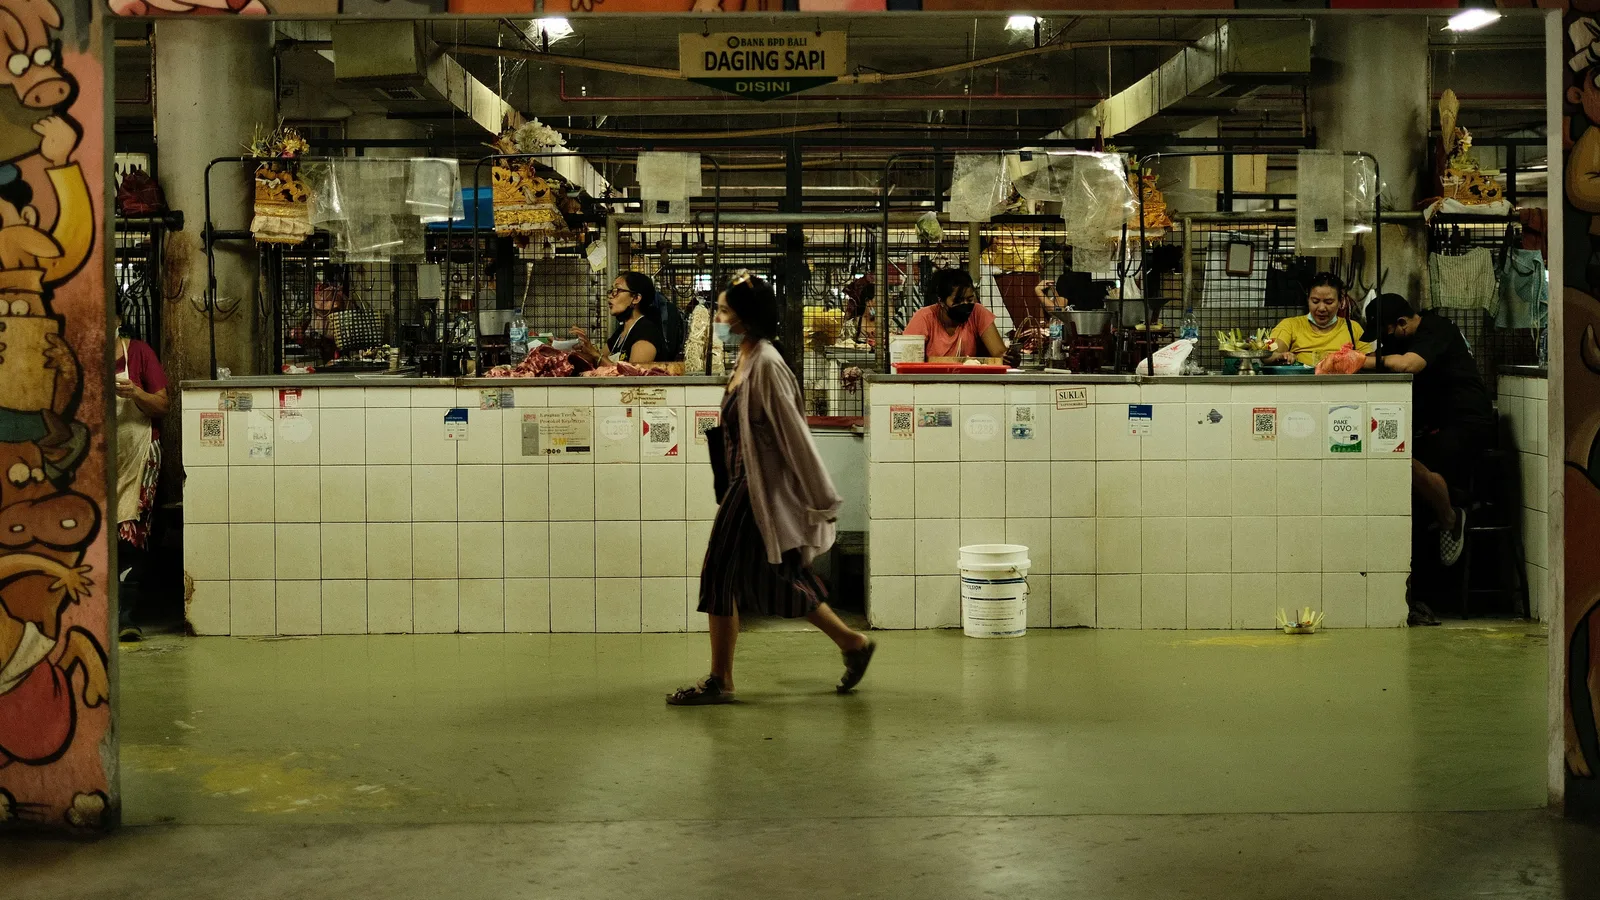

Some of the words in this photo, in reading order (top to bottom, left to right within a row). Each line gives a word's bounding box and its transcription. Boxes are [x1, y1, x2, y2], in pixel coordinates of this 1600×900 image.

[741, 37, 765, 47] BANK
[767, 37, 785, 47] BPD
[787, 37, 808, 47] BALI
[704, 50, 780, 71] DAGING
[784, 50, 826, 71] SAPI
[735, 81, 791, 92] DISINI
[1059, 390, 1085, 400] SUKLA
[1333, 424, 1352, 432] OVO
